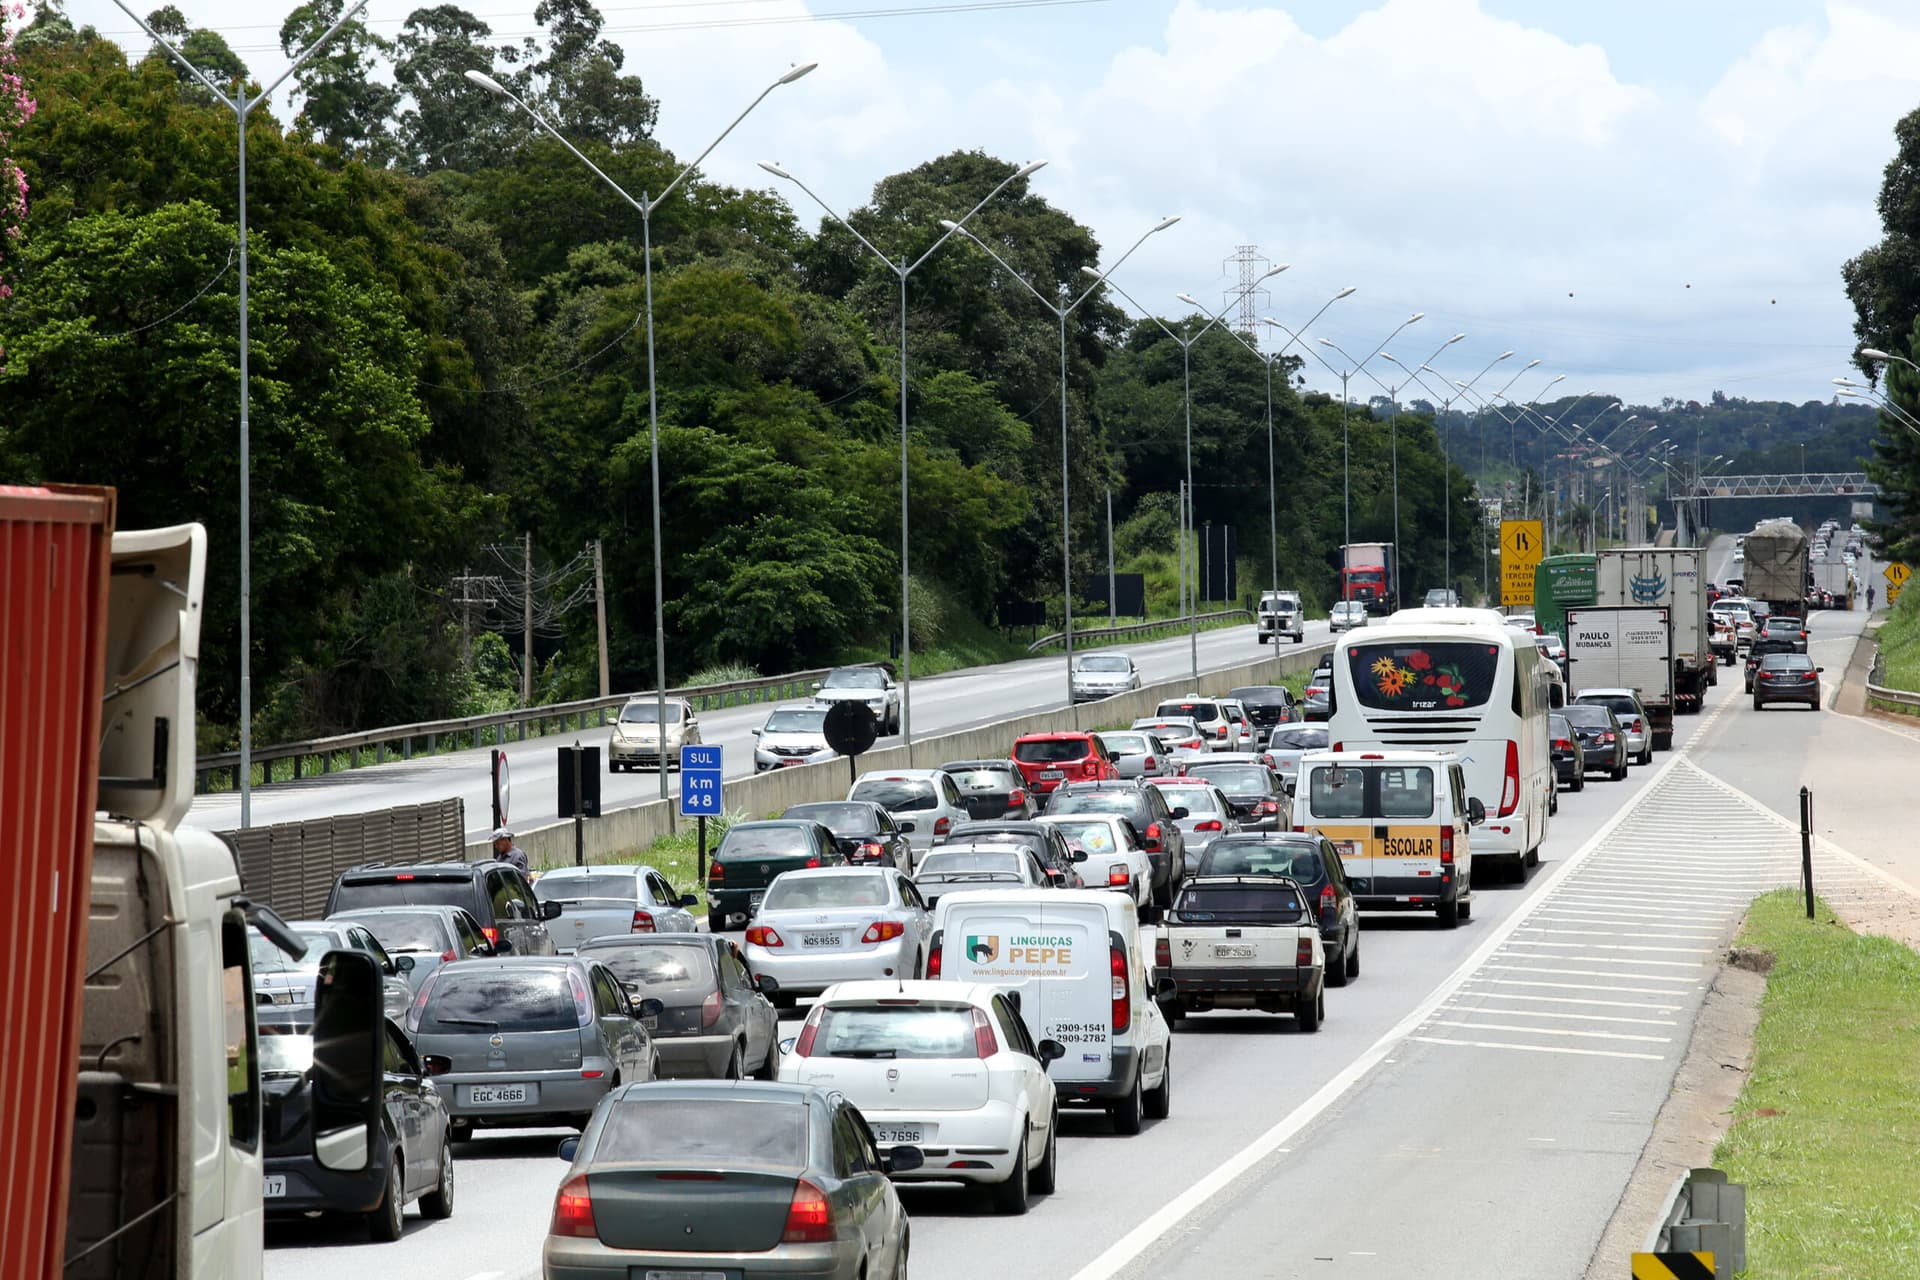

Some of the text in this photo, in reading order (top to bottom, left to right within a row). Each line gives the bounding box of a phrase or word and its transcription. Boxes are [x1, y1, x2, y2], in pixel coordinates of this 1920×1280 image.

[1579, 632, 1609, 641] PAULO
[690, 752, 713, 764] SUL
[689, 776, 713, 790] km
[687, 794, 713, 807] 48
[1383, 839, 1433, 856] ESCOLAR
[1010, 936, 1073, 947] LINGUIÇAS
[1009, 948, 1072, 964] PEPE
[972, 968, 1067, 976] www.linguicaspepe.com.br
[1055, 1024, 1106, 1032] 2909-1541
[1056, 1034, 1106, 1043] 2909-2782
